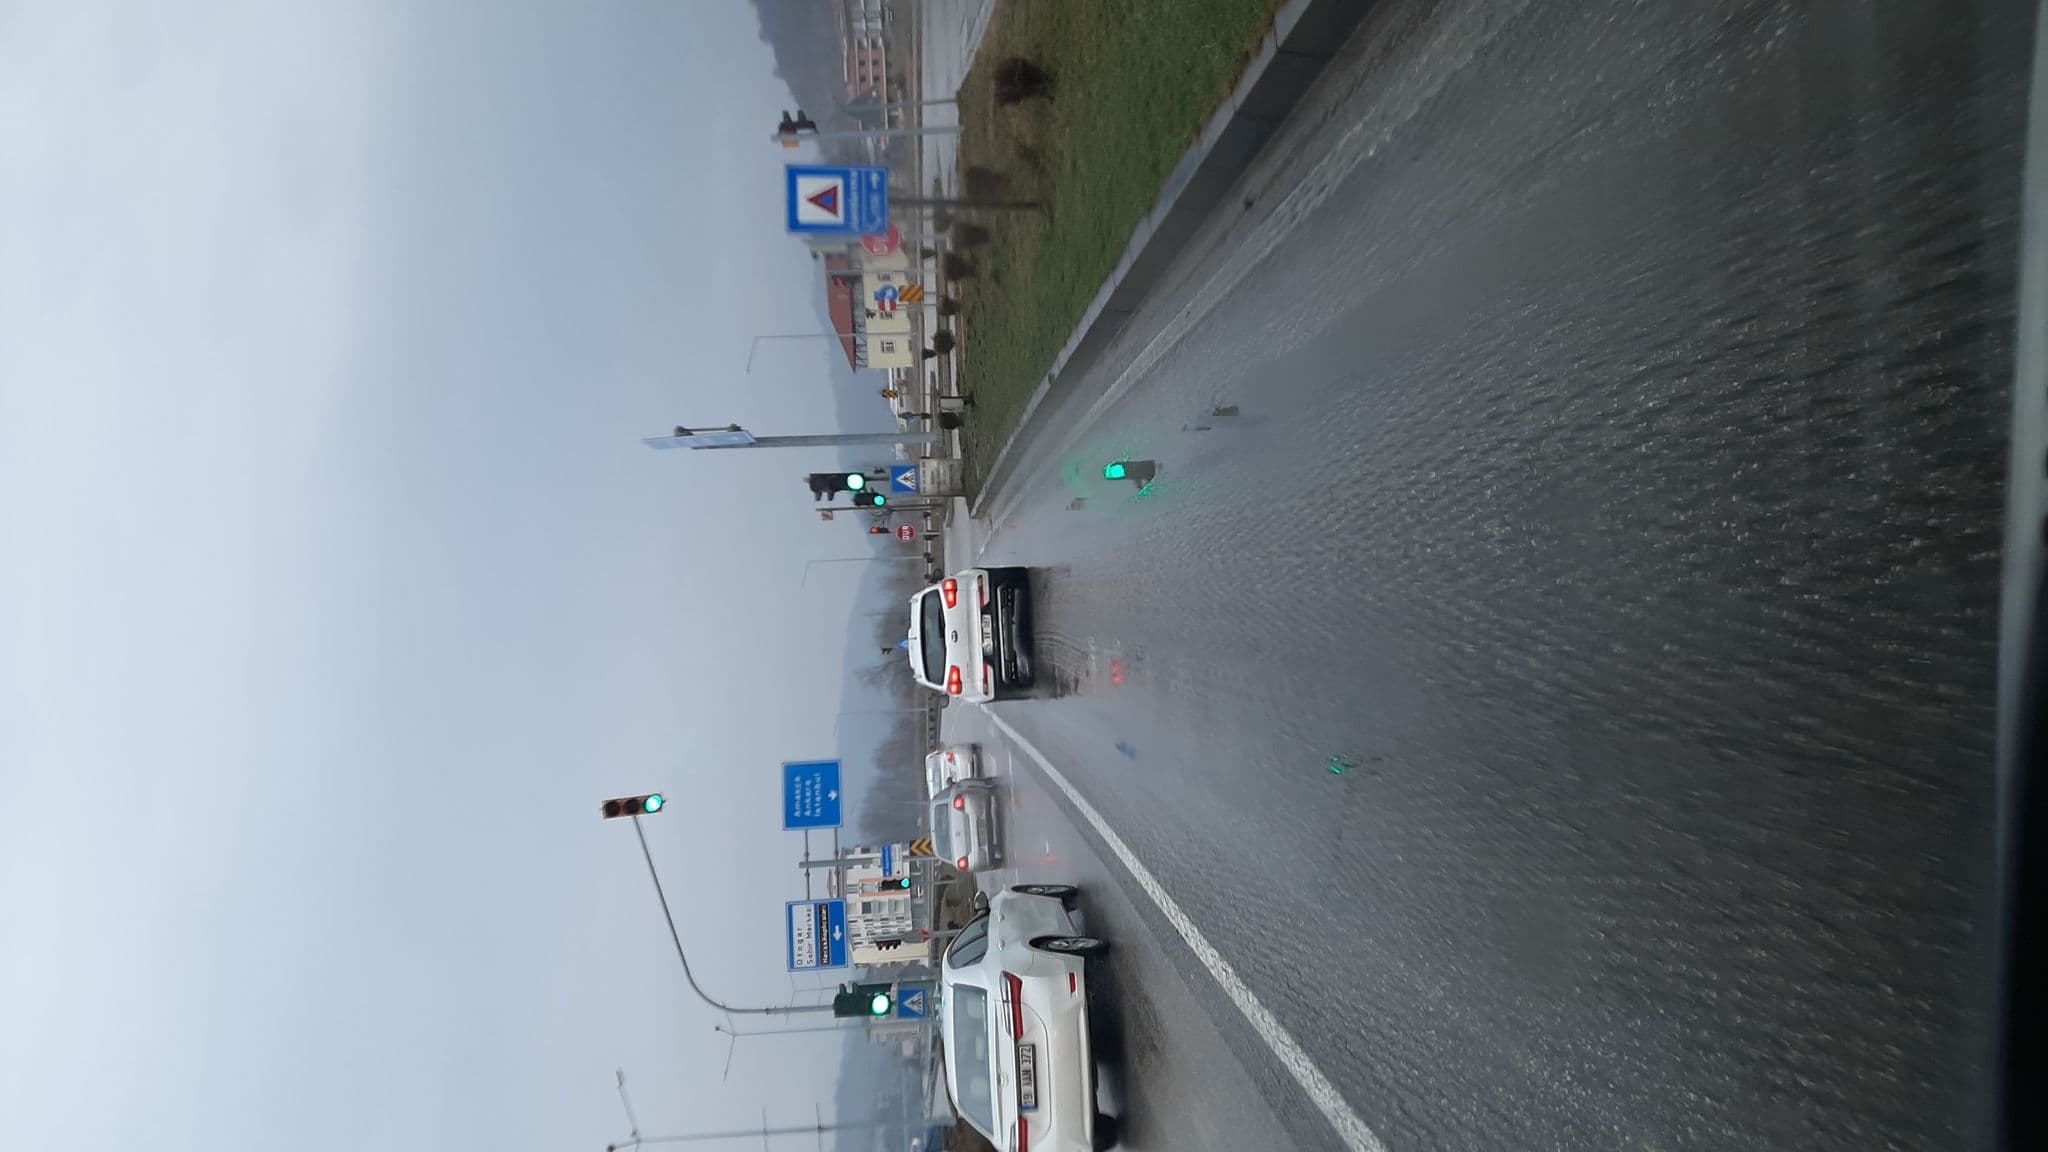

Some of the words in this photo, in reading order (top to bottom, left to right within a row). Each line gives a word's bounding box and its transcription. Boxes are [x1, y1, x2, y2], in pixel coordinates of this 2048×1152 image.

[902, 525, 910, 541] DUR
[1021, 1047, 1031, 1065] 372
[1023, 1094, 1032, 1104] 19
